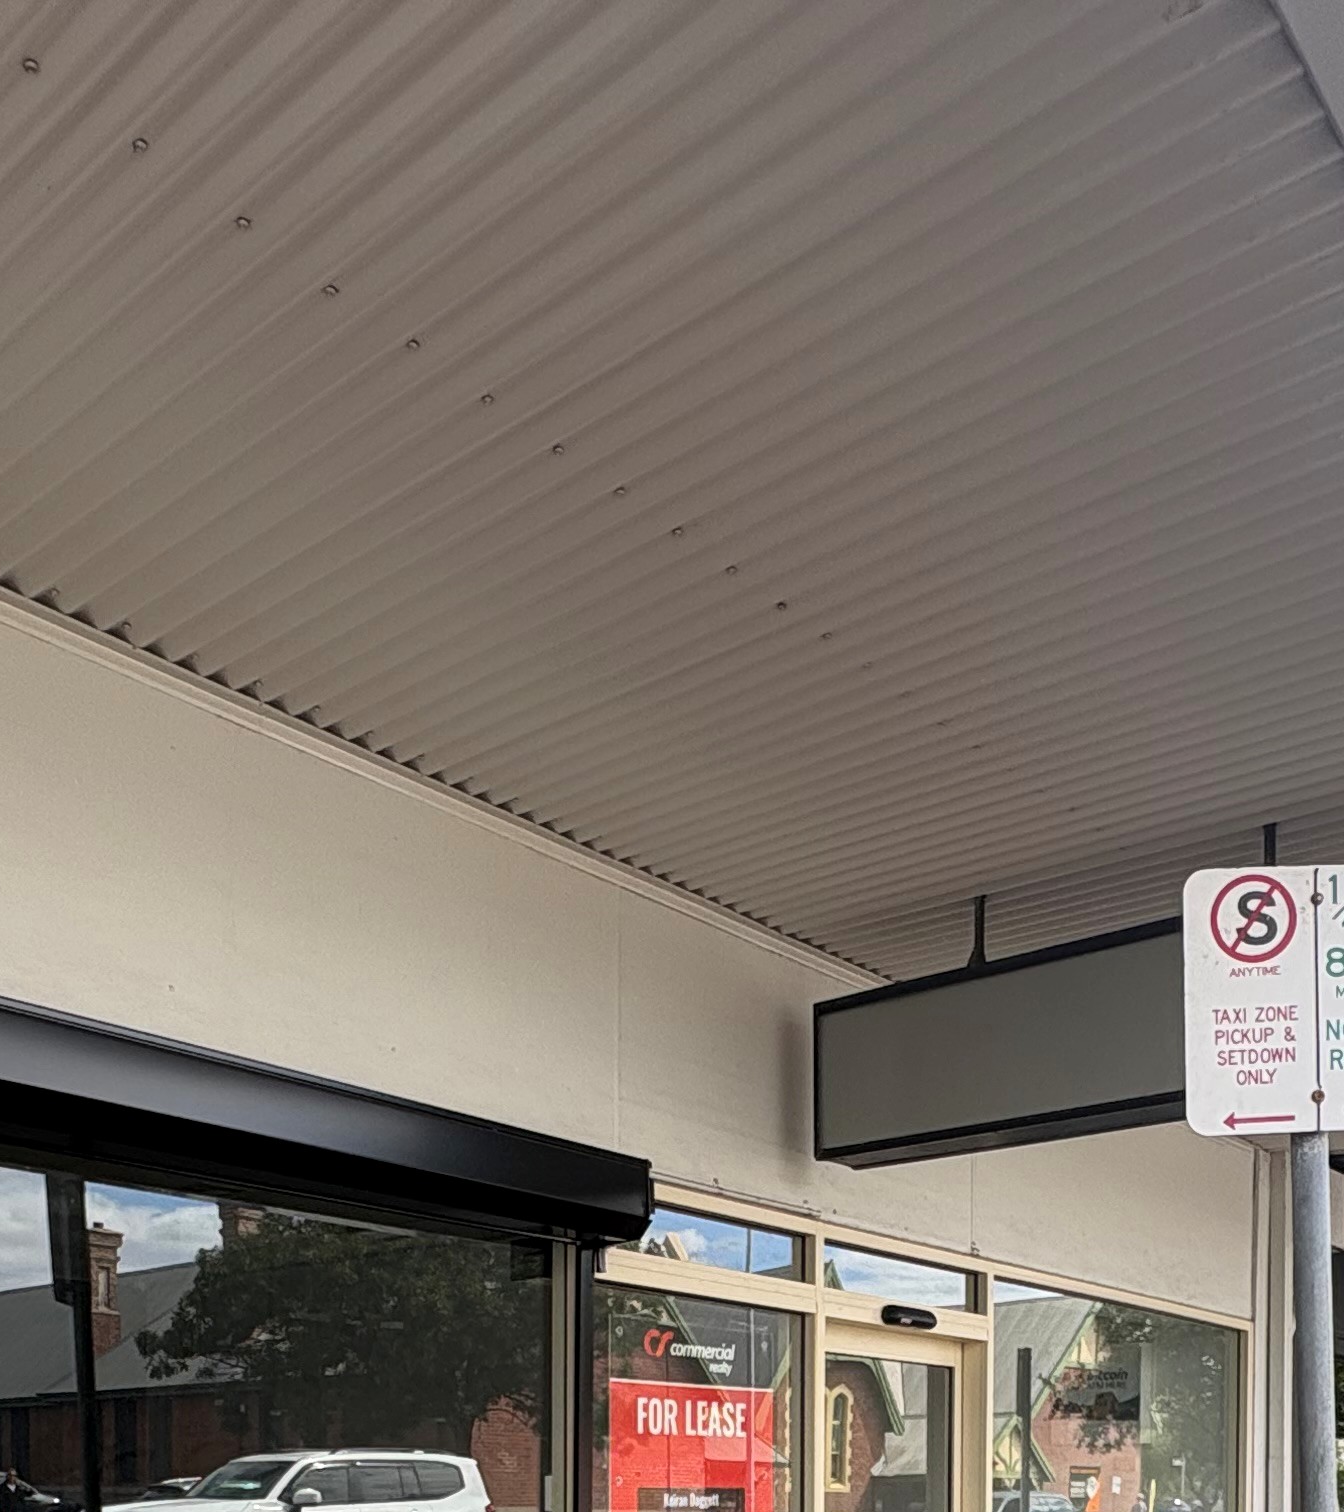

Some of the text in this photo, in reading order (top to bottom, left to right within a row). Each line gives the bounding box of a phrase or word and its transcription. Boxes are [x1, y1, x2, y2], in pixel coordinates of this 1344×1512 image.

[1229, 965, 1281, 978] ANYTIME
[1212, 1005, 1299, 1025] TAXI ZONE
[1214, 1026, 1297, 1045] PICKUP &
[1216, 1048, 1297, 1066] SETDOWN
[1236, 1068, 1278, 1086] ONLY
[669, 1342, 737, 1362] commercial
[708, 1361, 733, 1378] realty
[636, 1396, 747, 1438] FOR LEASE
